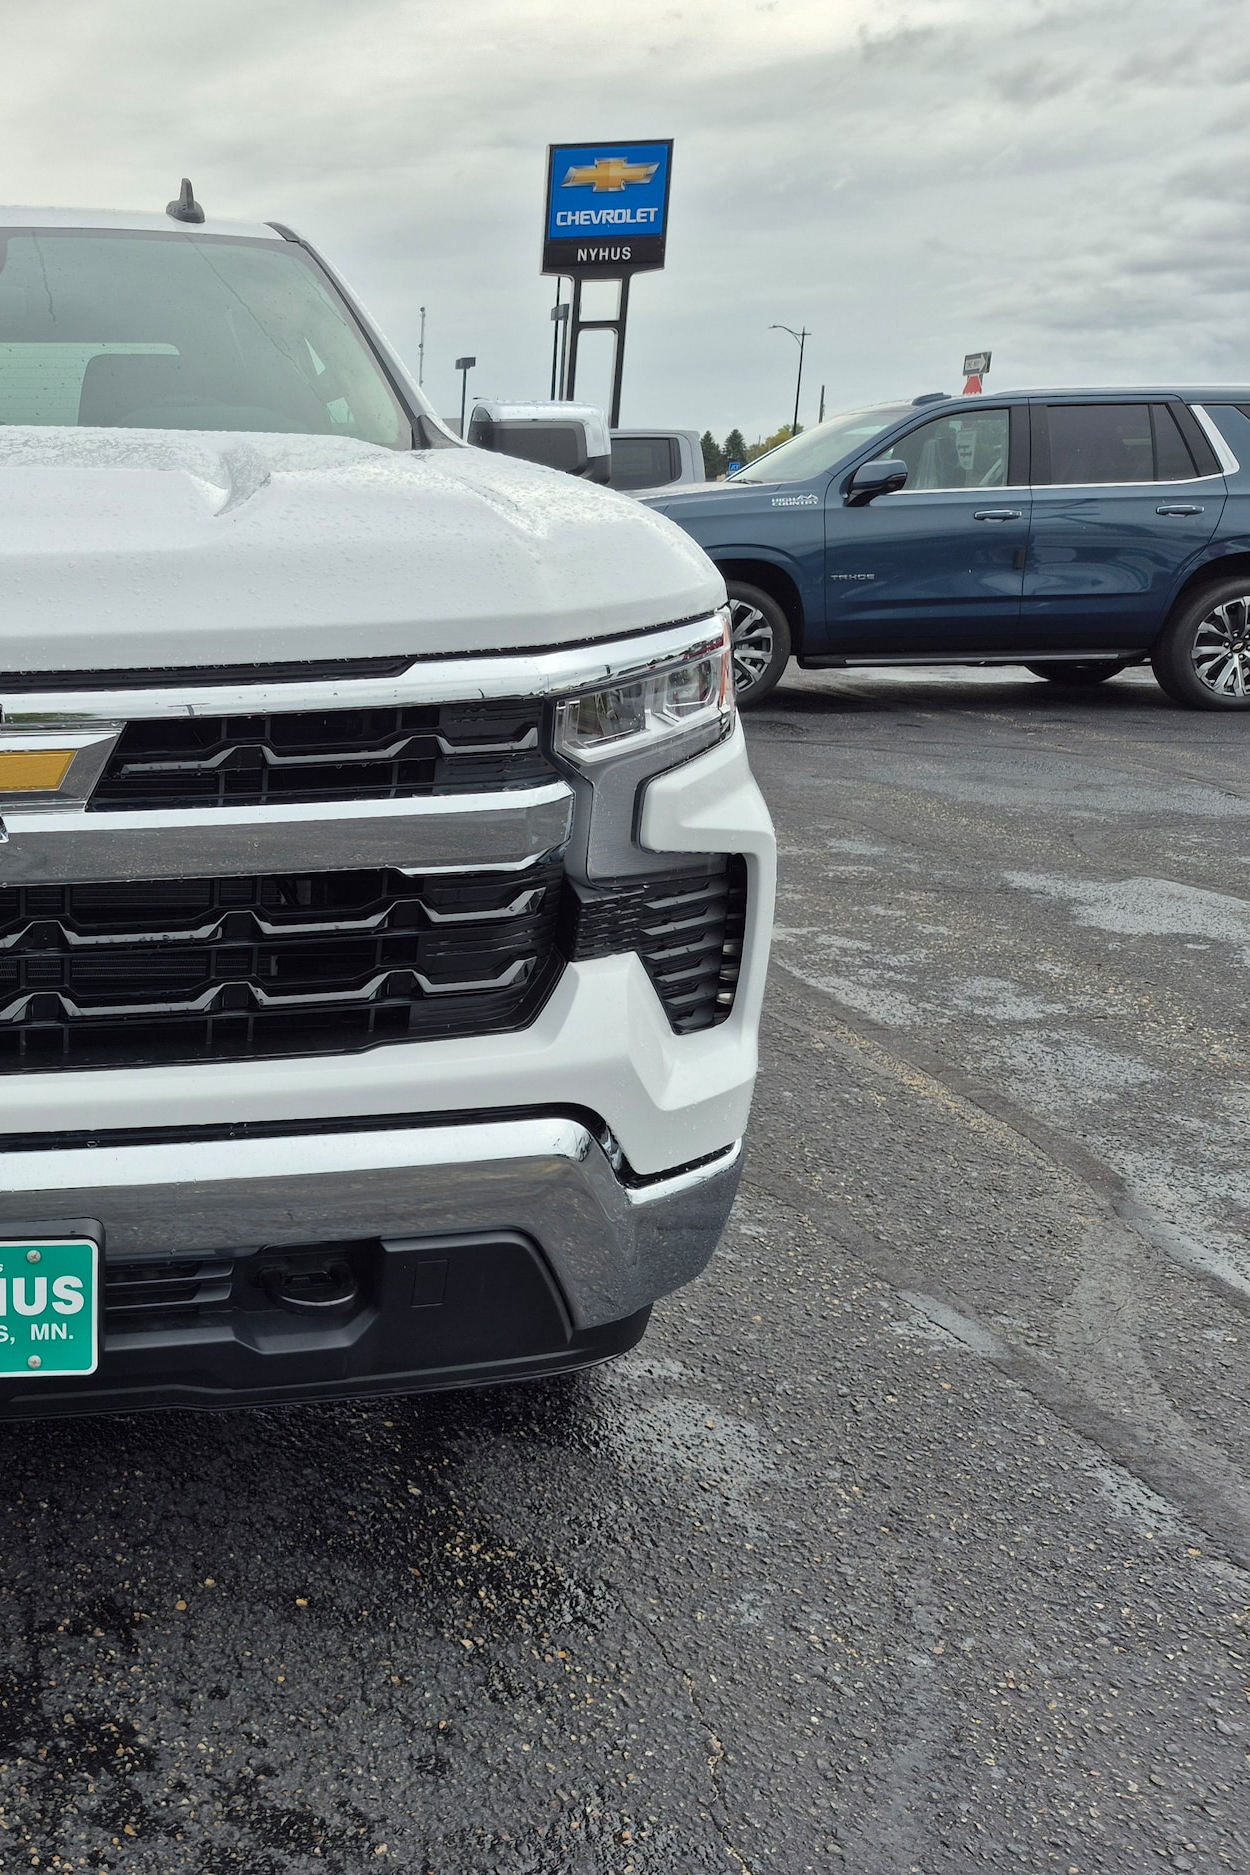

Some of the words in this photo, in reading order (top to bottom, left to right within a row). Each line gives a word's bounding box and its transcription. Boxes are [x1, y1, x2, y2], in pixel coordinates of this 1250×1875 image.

[556, 207, 658, 226] CHEVROLET
[577, 246, 632, 262] NYHUS
[830, 573, 875, 581] TAHOE
[30, 1323, 74, 1341] MN.
